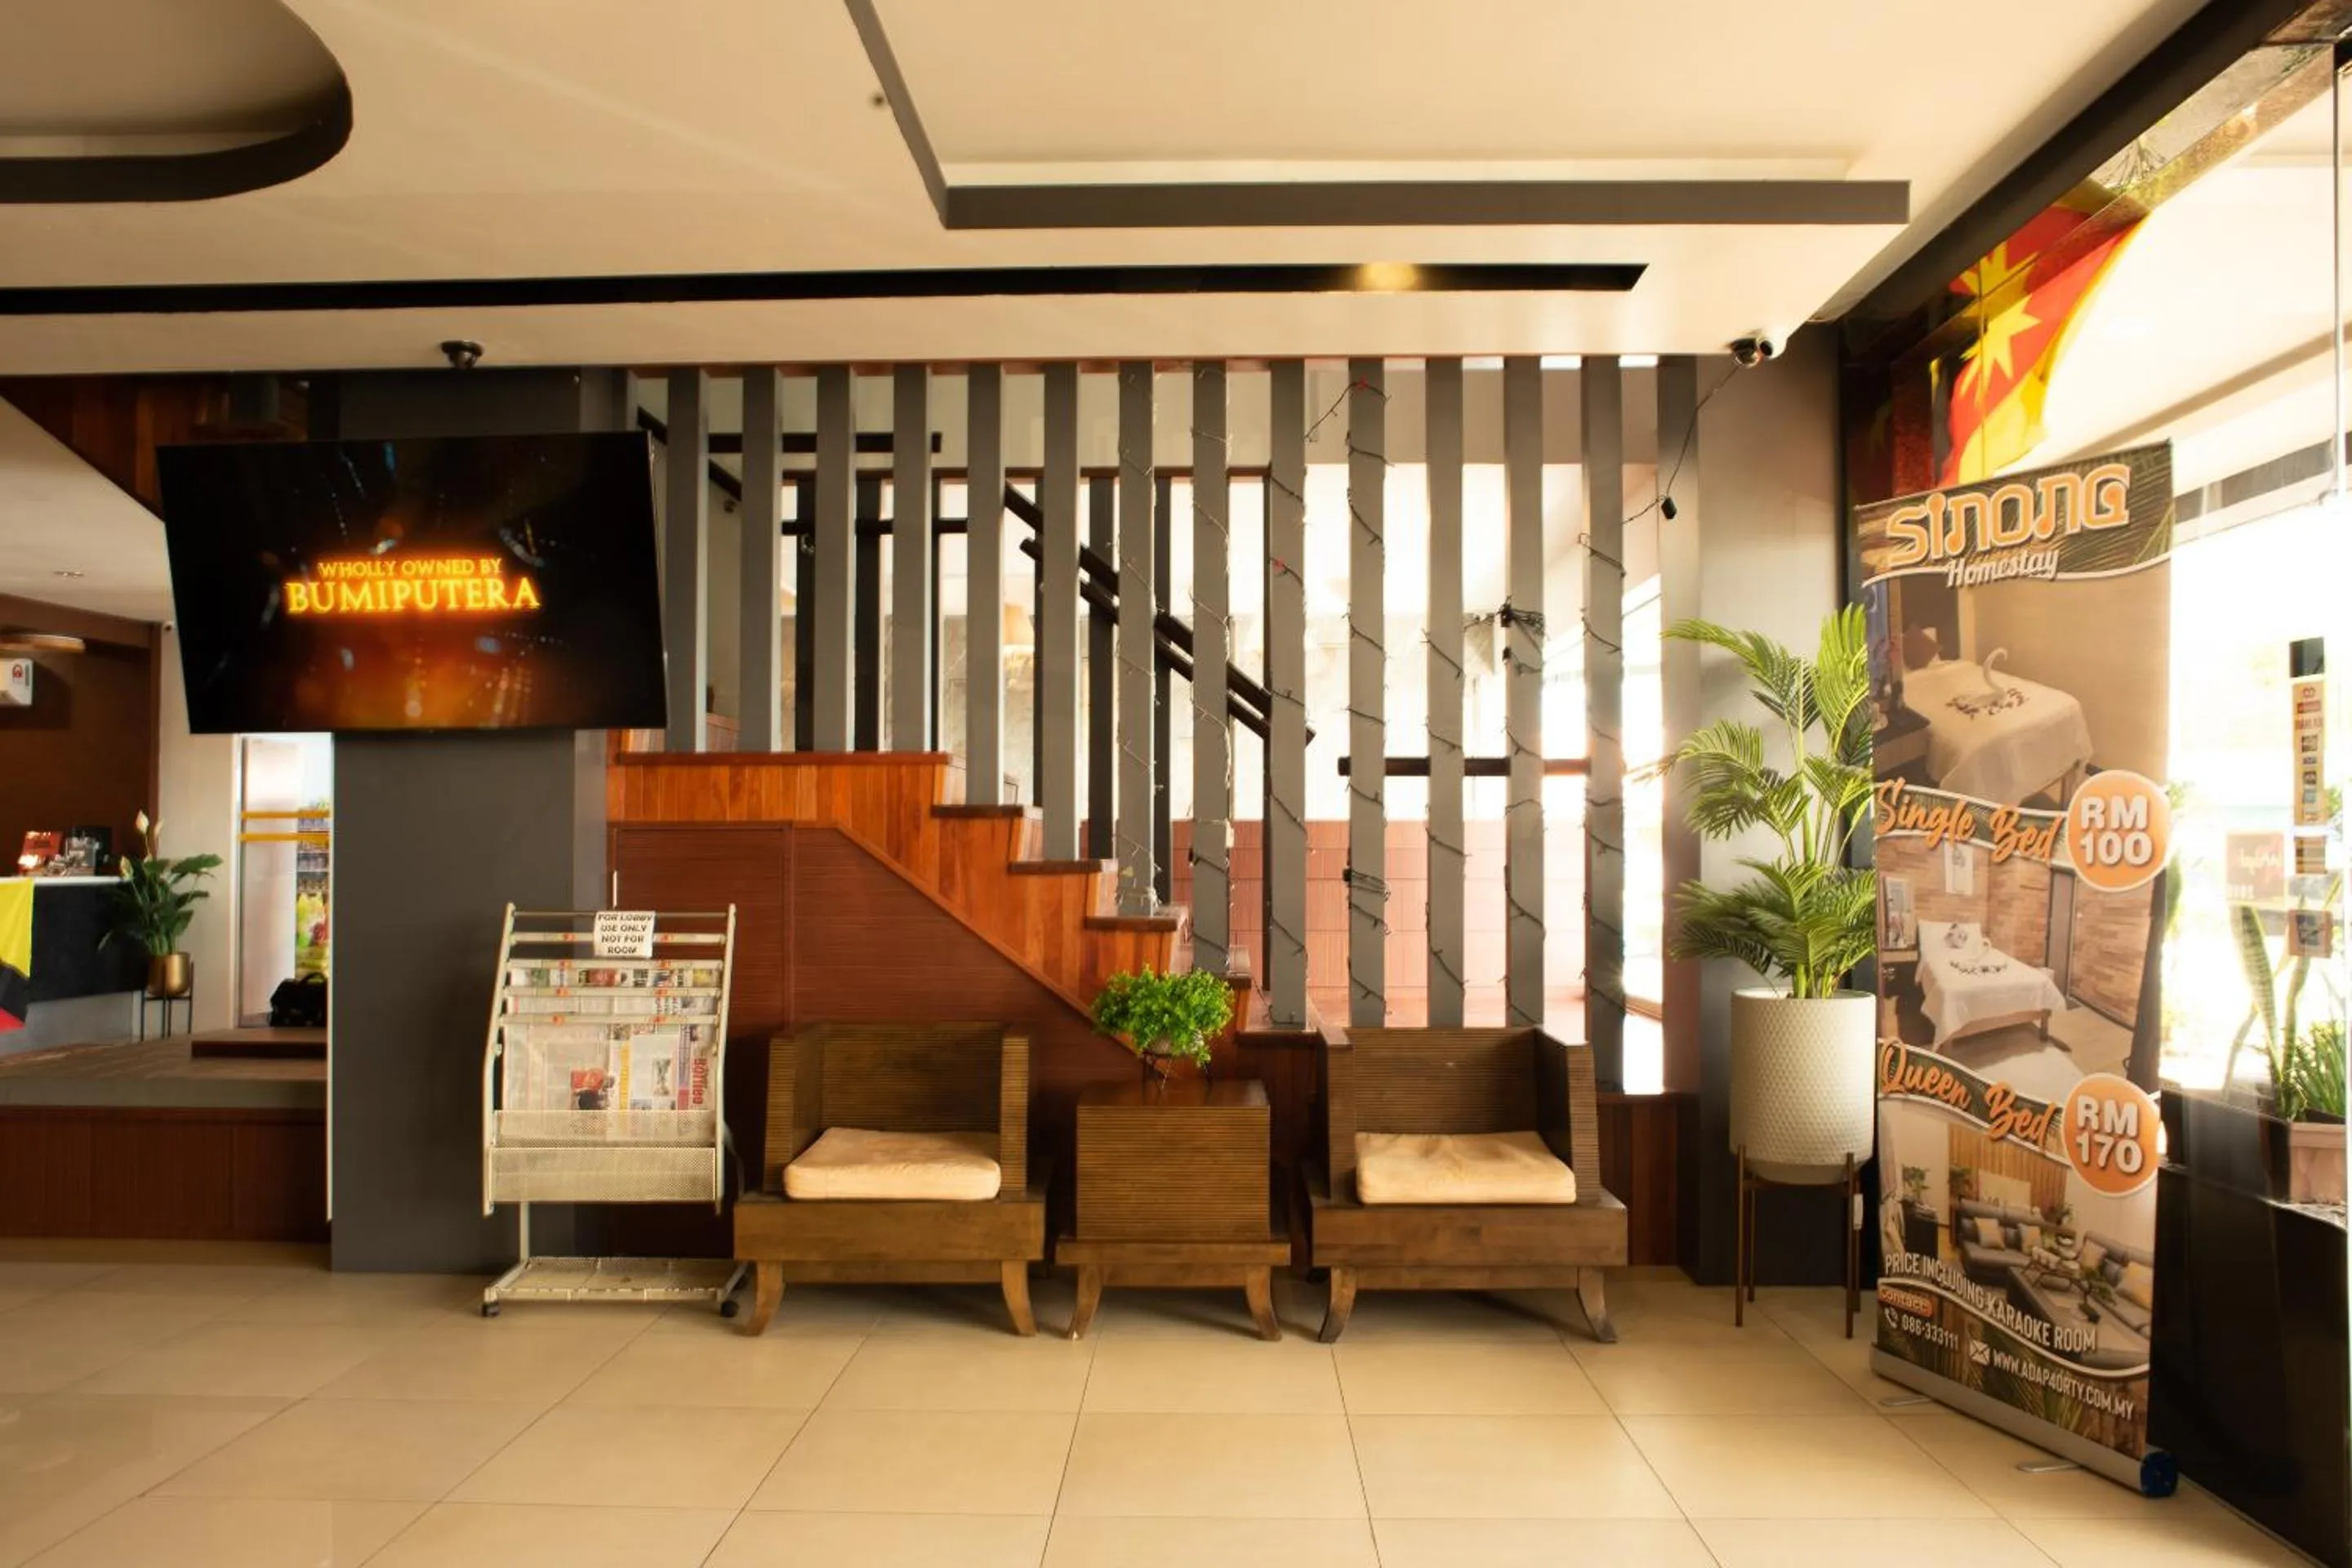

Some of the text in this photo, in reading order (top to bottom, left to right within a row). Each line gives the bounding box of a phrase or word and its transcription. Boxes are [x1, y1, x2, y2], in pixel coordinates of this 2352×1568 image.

[317, 558, 502, 578] WHOLLY OWNED BY
[1938, 550, 2059, 587] Homestay
[285, 577, 540, 612] BUMIPUTERA
[1876, 777, 2062, 864] Single Bed
[2080, 795, 2148, 830] RM
[2079, 831, 2153, 866] 100
[1881, 1037, 2056, 1148] Queen Bed
[2077, 1095, 2139, 1138] RM
[2075, 1133, 2143, 1174] 170
[1885, 1253, 2096, 1353] PRICE INCLUDING KARAOKE ROOM
